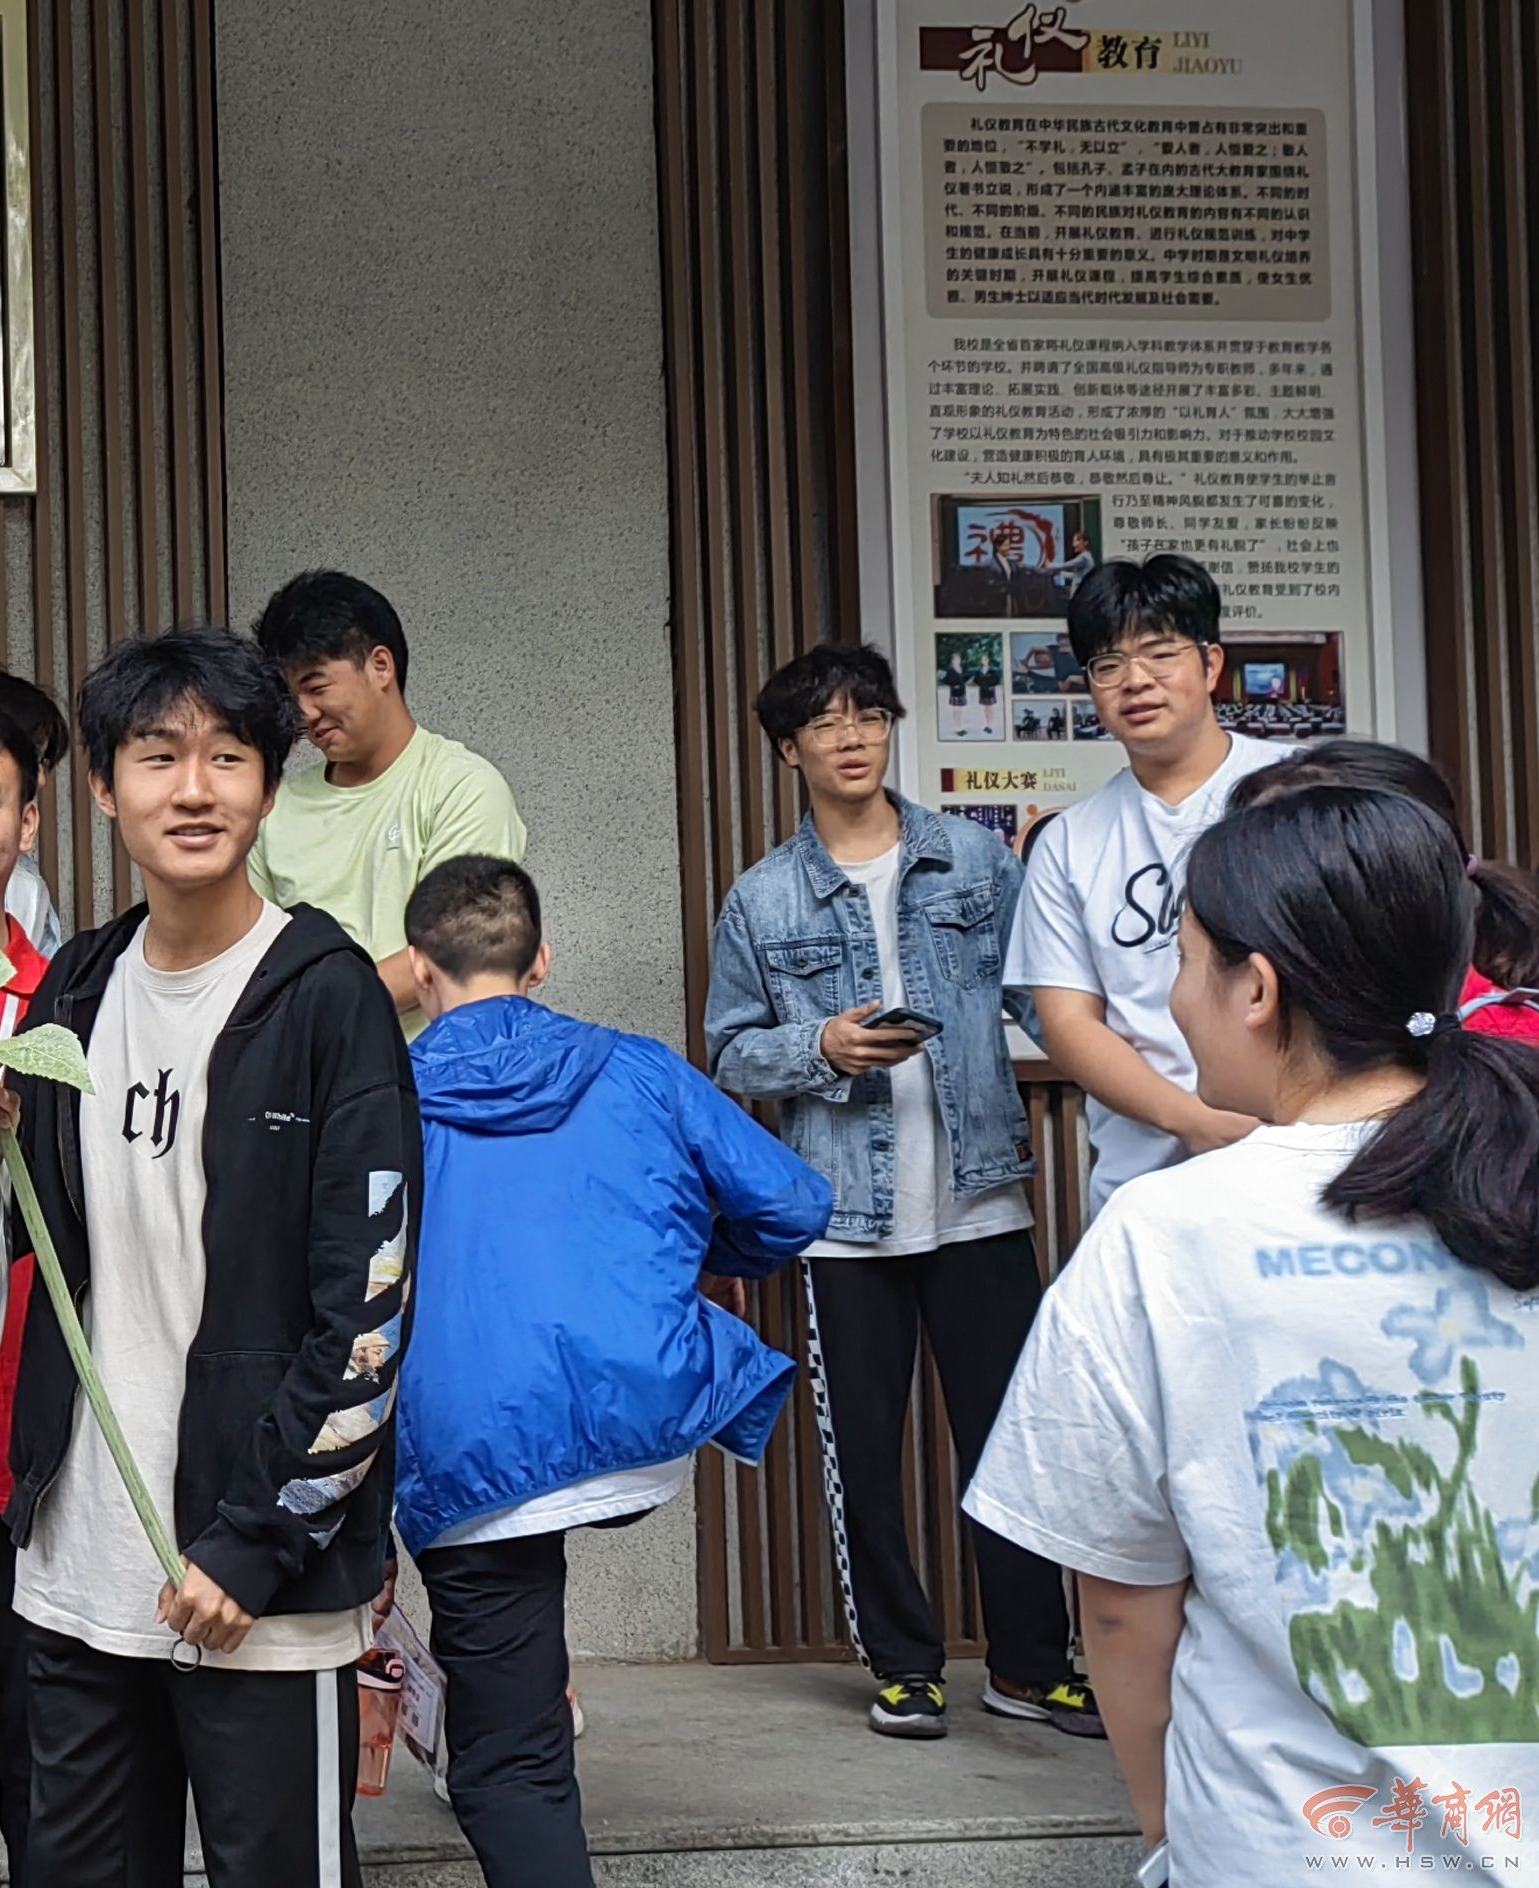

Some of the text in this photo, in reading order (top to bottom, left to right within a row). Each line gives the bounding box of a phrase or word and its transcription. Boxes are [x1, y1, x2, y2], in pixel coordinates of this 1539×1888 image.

[958, 3, 1163, 92] 礼仪 教育
[1174, 31, 1210, 50] LIYI
[1173, 57, 1243, 76] JIAOYU
[1219, 582, 1341, 599] 礼仪教育受到了校内
[965, 770, 1038, 791] 礼仪大赛
[1254, 1240, 1452, 1278] MECON
